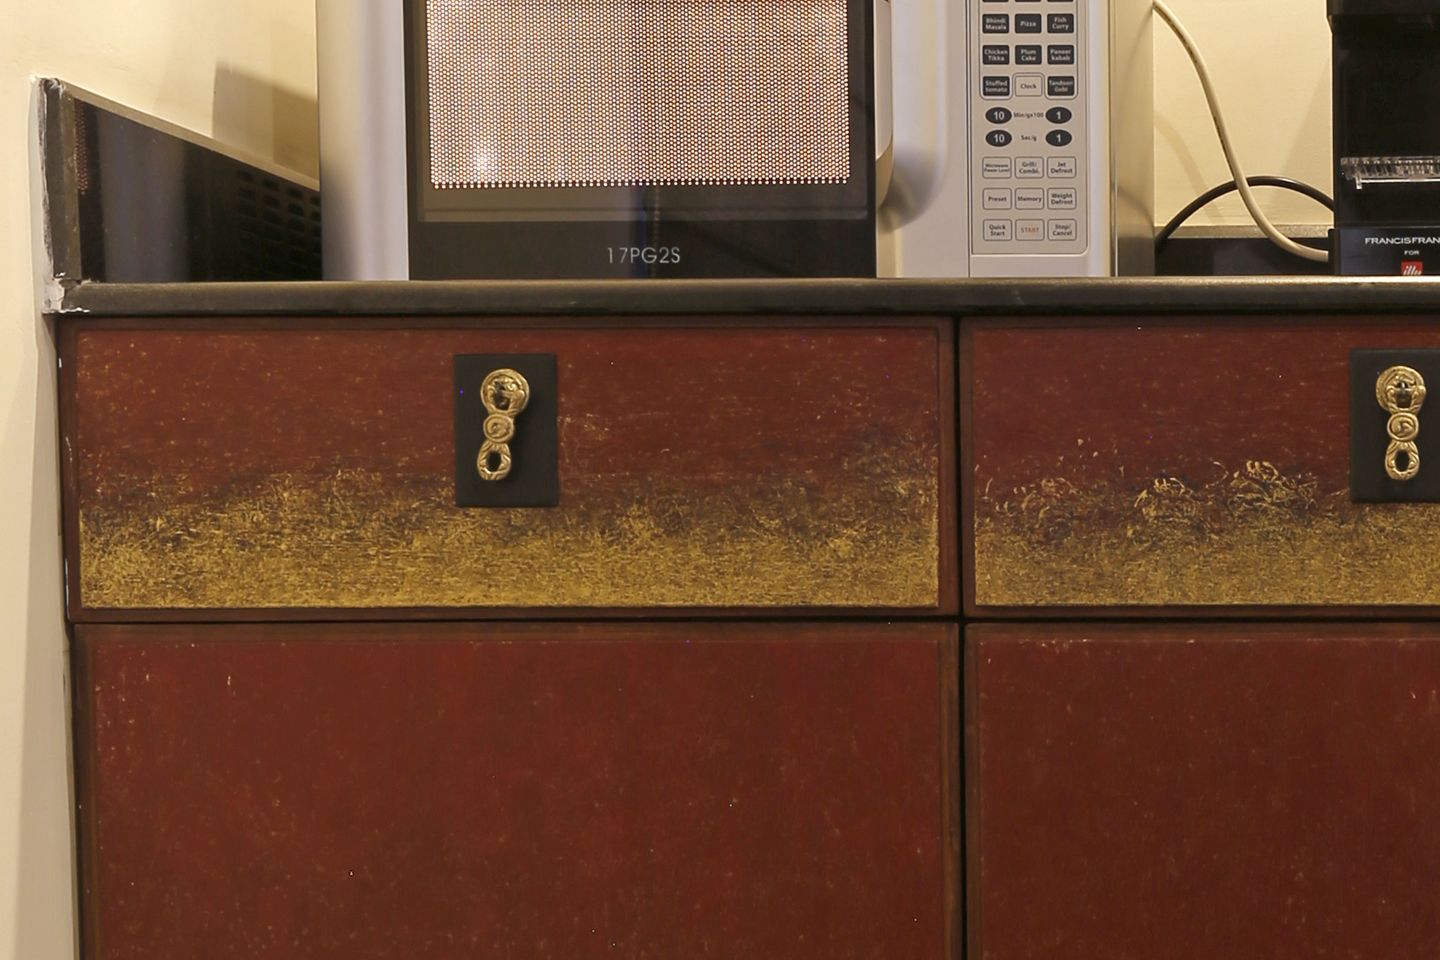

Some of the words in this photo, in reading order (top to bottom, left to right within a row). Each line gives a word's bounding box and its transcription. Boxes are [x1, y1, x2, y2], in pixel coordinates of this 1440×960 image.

[993, 111, 1004, 120] 10
[1056, 111, 1061, 120] 1
[994, 134, 1005, 143] 10
[1056, 134, 1061, 142] 1
[607, 247, 680, 264] 17PG2S
